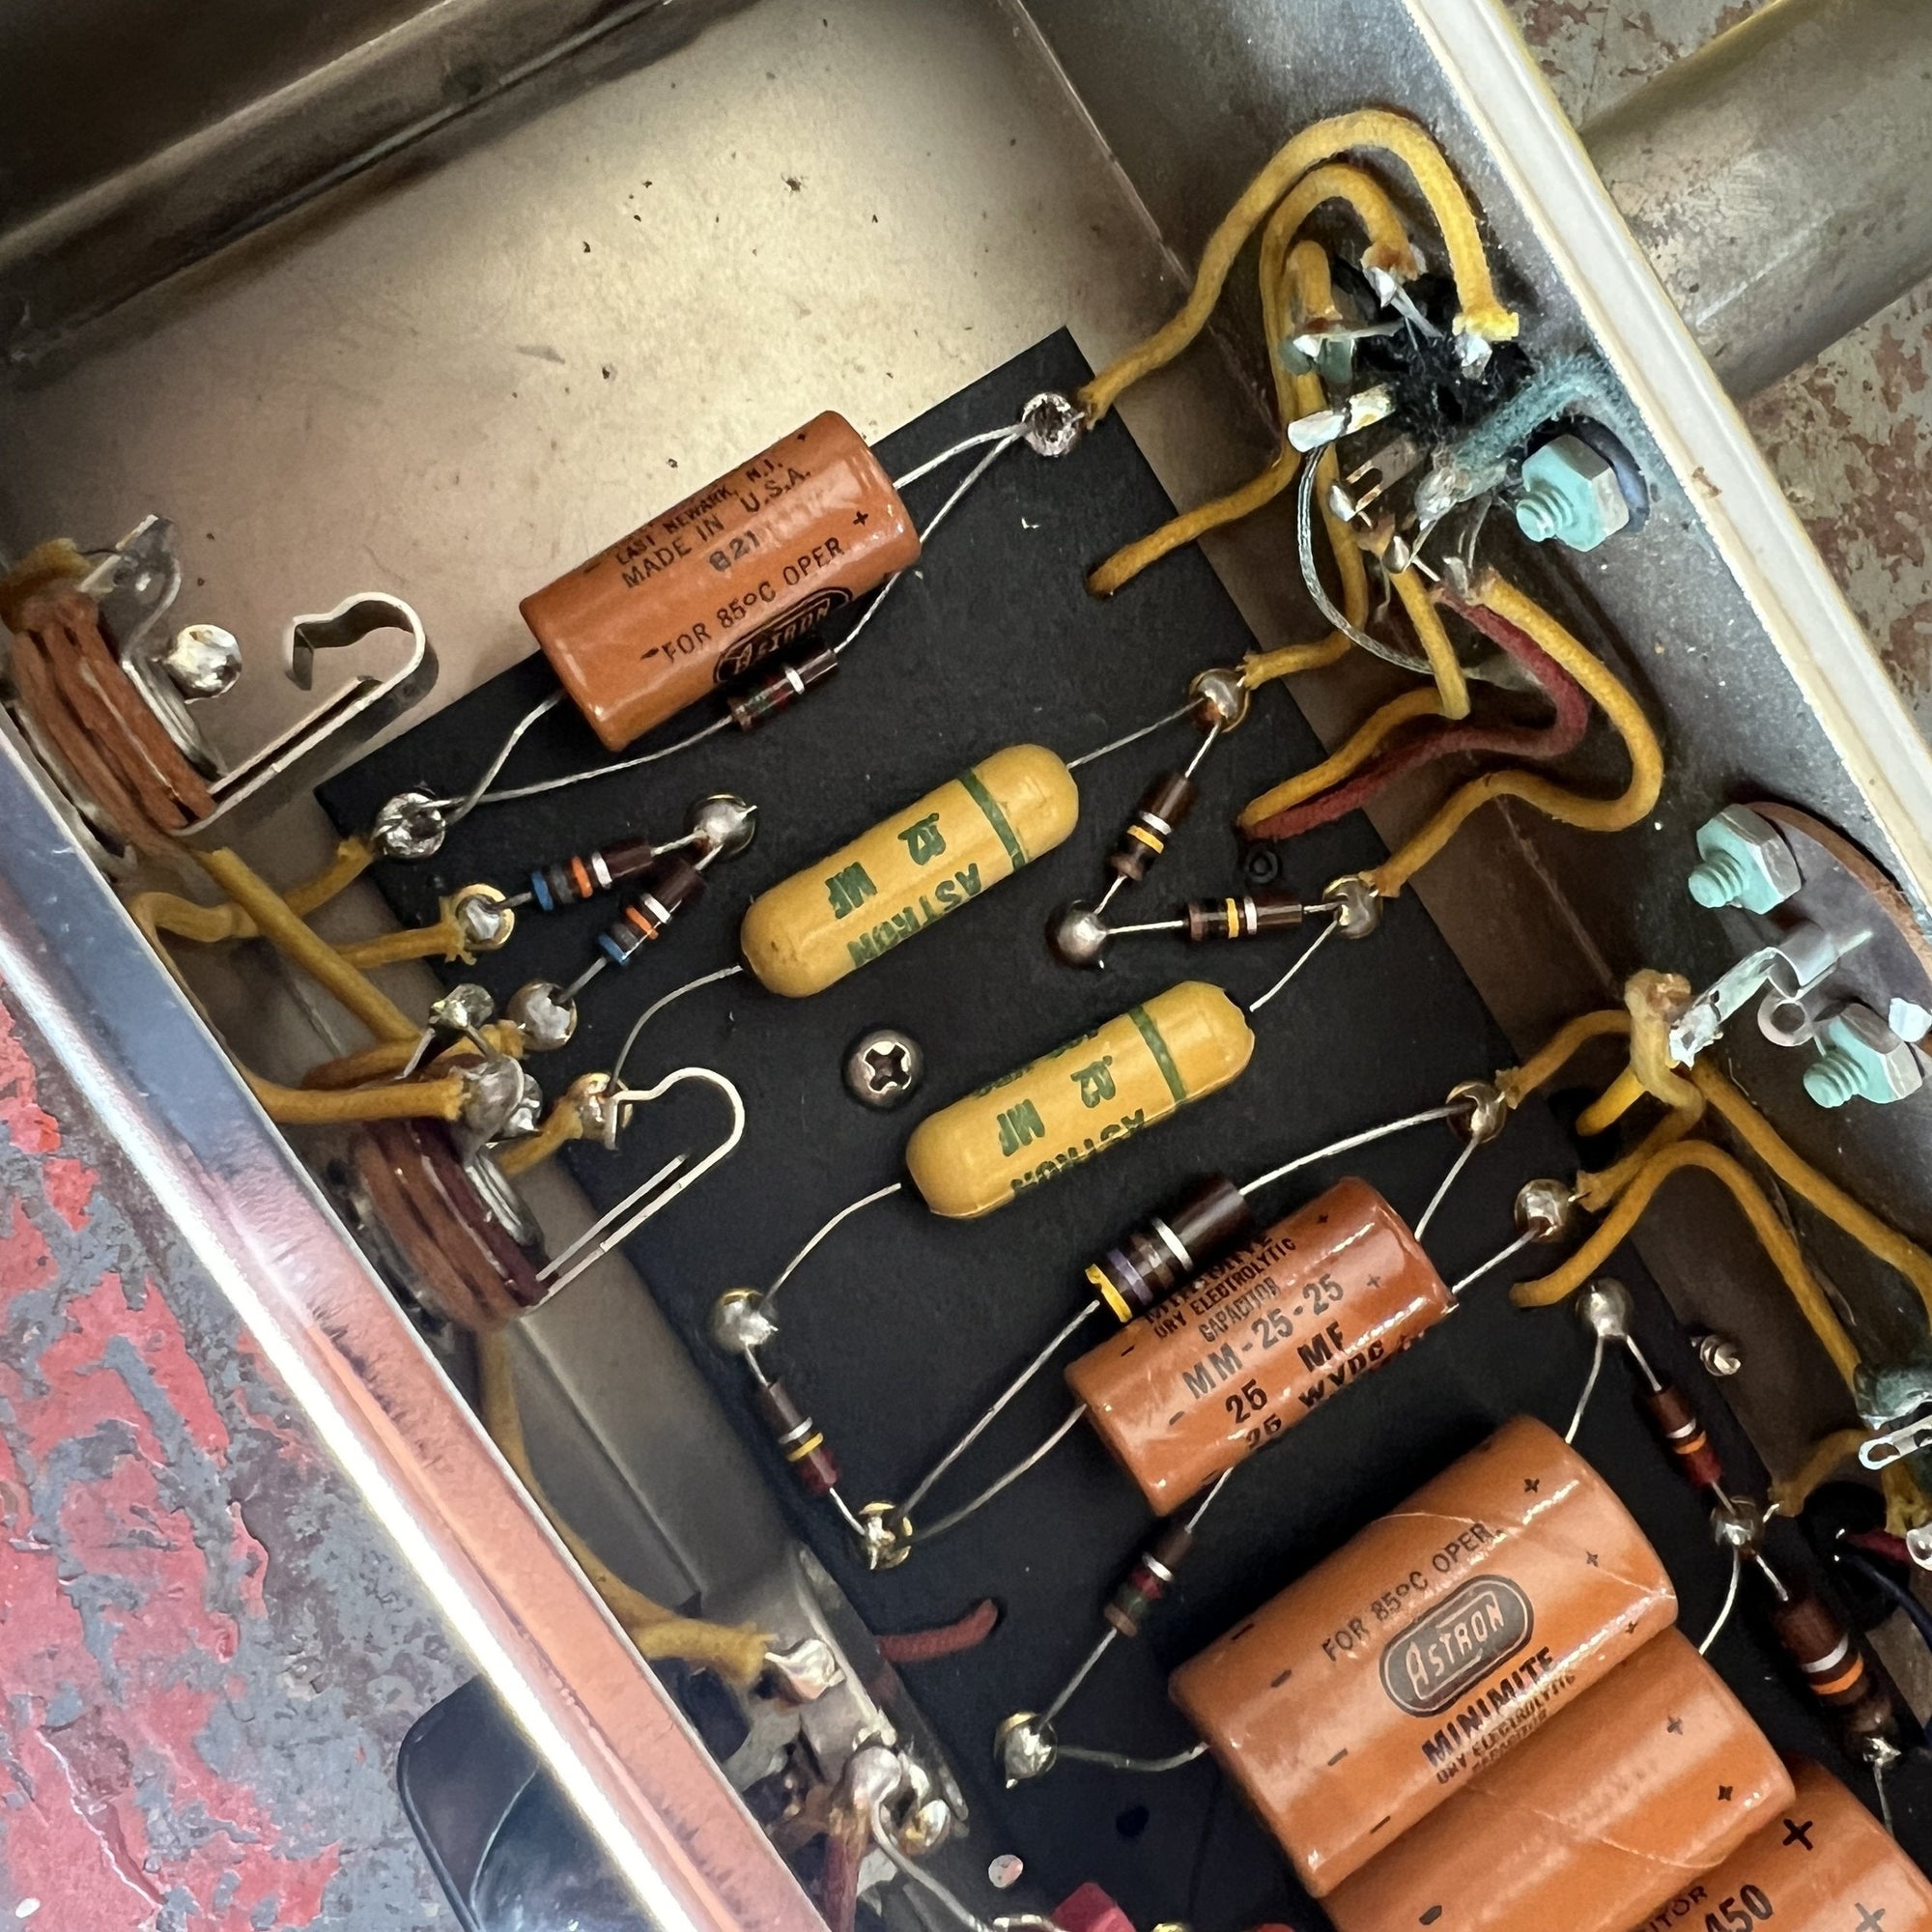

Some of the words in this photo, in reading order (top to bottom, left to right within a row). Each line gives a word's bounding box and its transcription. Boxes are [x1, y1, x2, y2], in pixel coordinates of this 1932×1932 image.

[622, 536, 692, 588] MADE
[696, 515, 724, 541] IN
[740, 468, 811, 513] U.S.A.
[662, 622, 712, 664] FOR
[782, 537, 845, 585] OPER
[824, 859, 880, 921] MF
[847, 863, 981, 967] ASTRON
[1154, 1311, 1186, 1340] DRY
[1189, 1238, 1295, 1316] ELECTROLYTIC
[1182, 1268, 1344, 1400] MM-25-25
[1199, 1277, 1284, 1343] CAPACITOR
[1225, 1378, 1267, 1424] 25
[1296, 1320, 1345, 1373] MF
[1321, 1617, 1370, 1662] FOR
[1433, 1522, 1507, 1574] OPER.
[1404, 1592, 1507, 1696] ASTRON
[1422, 1646, 1553, 1767] MINIMITE
